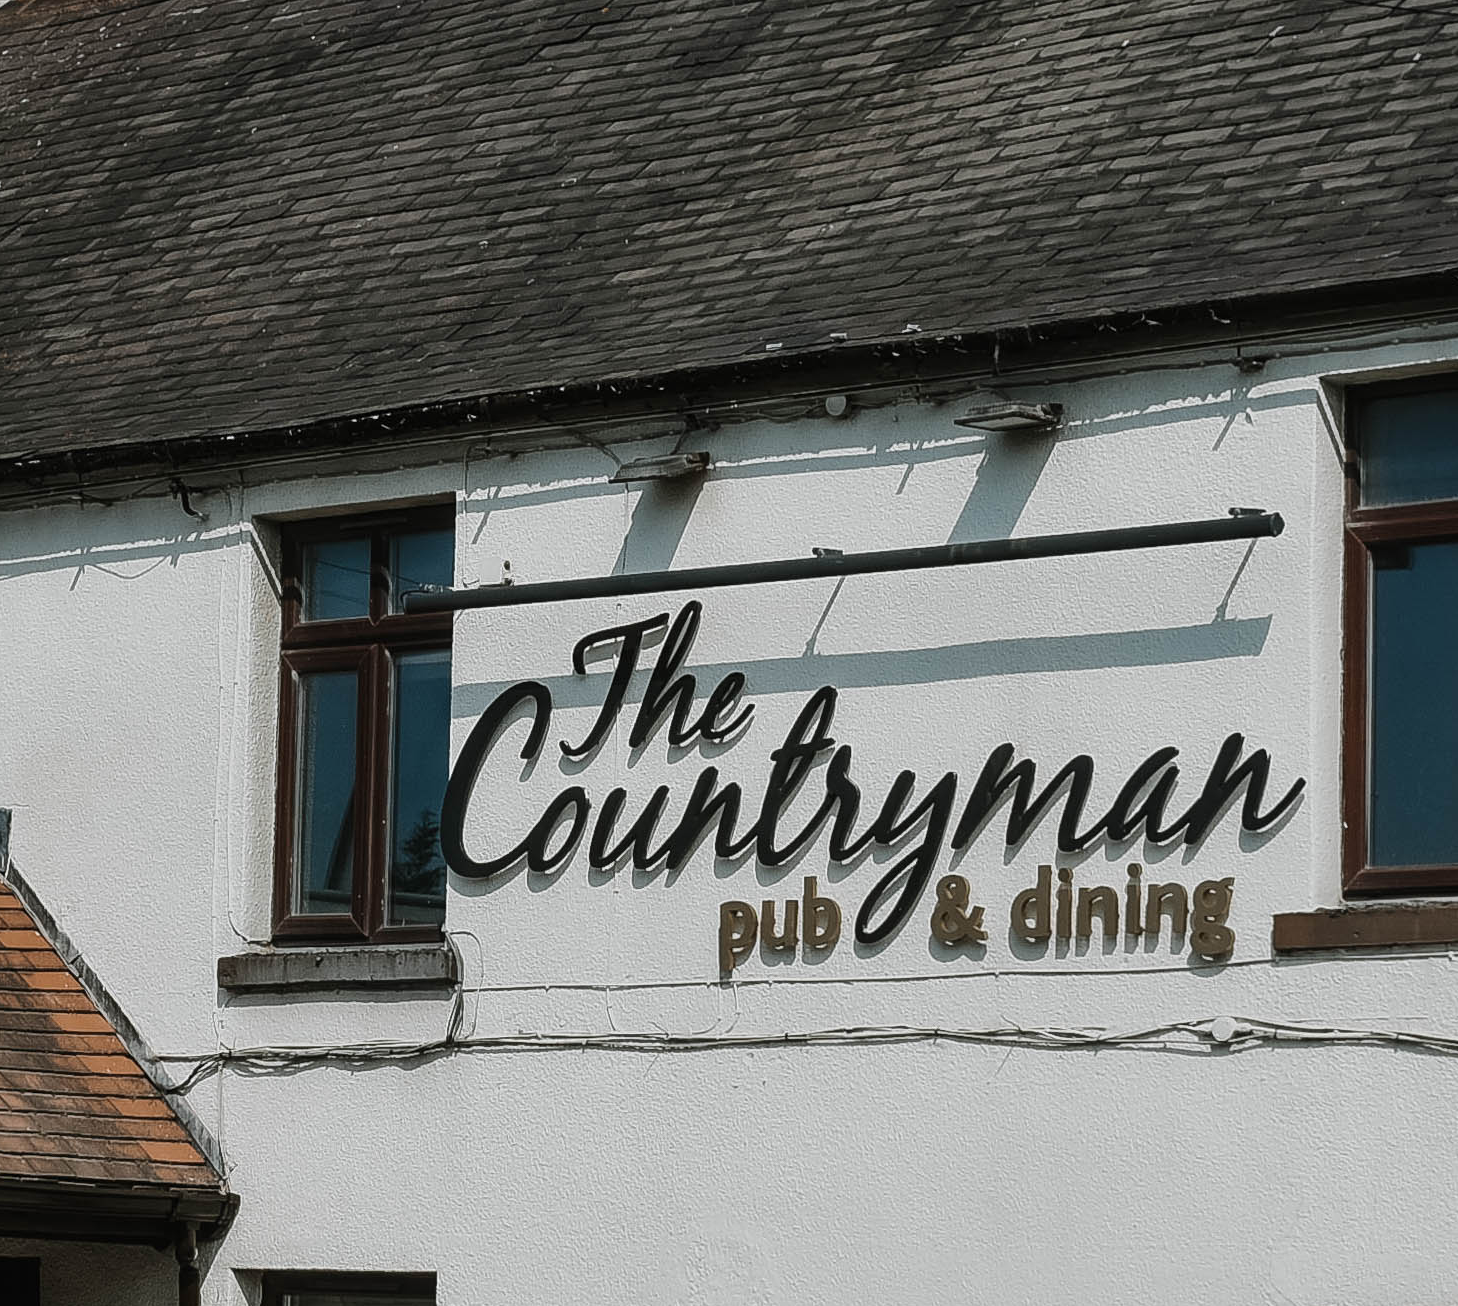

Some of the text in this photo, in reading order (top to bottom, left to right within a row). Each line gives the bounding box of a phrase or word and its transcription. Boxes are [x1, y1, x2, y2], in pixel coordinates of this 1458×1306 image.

[560, 600, 755, 758] The
[439, 681, 1307, 945] Countryman
[718, 862, 1235, 973] pub & dining
